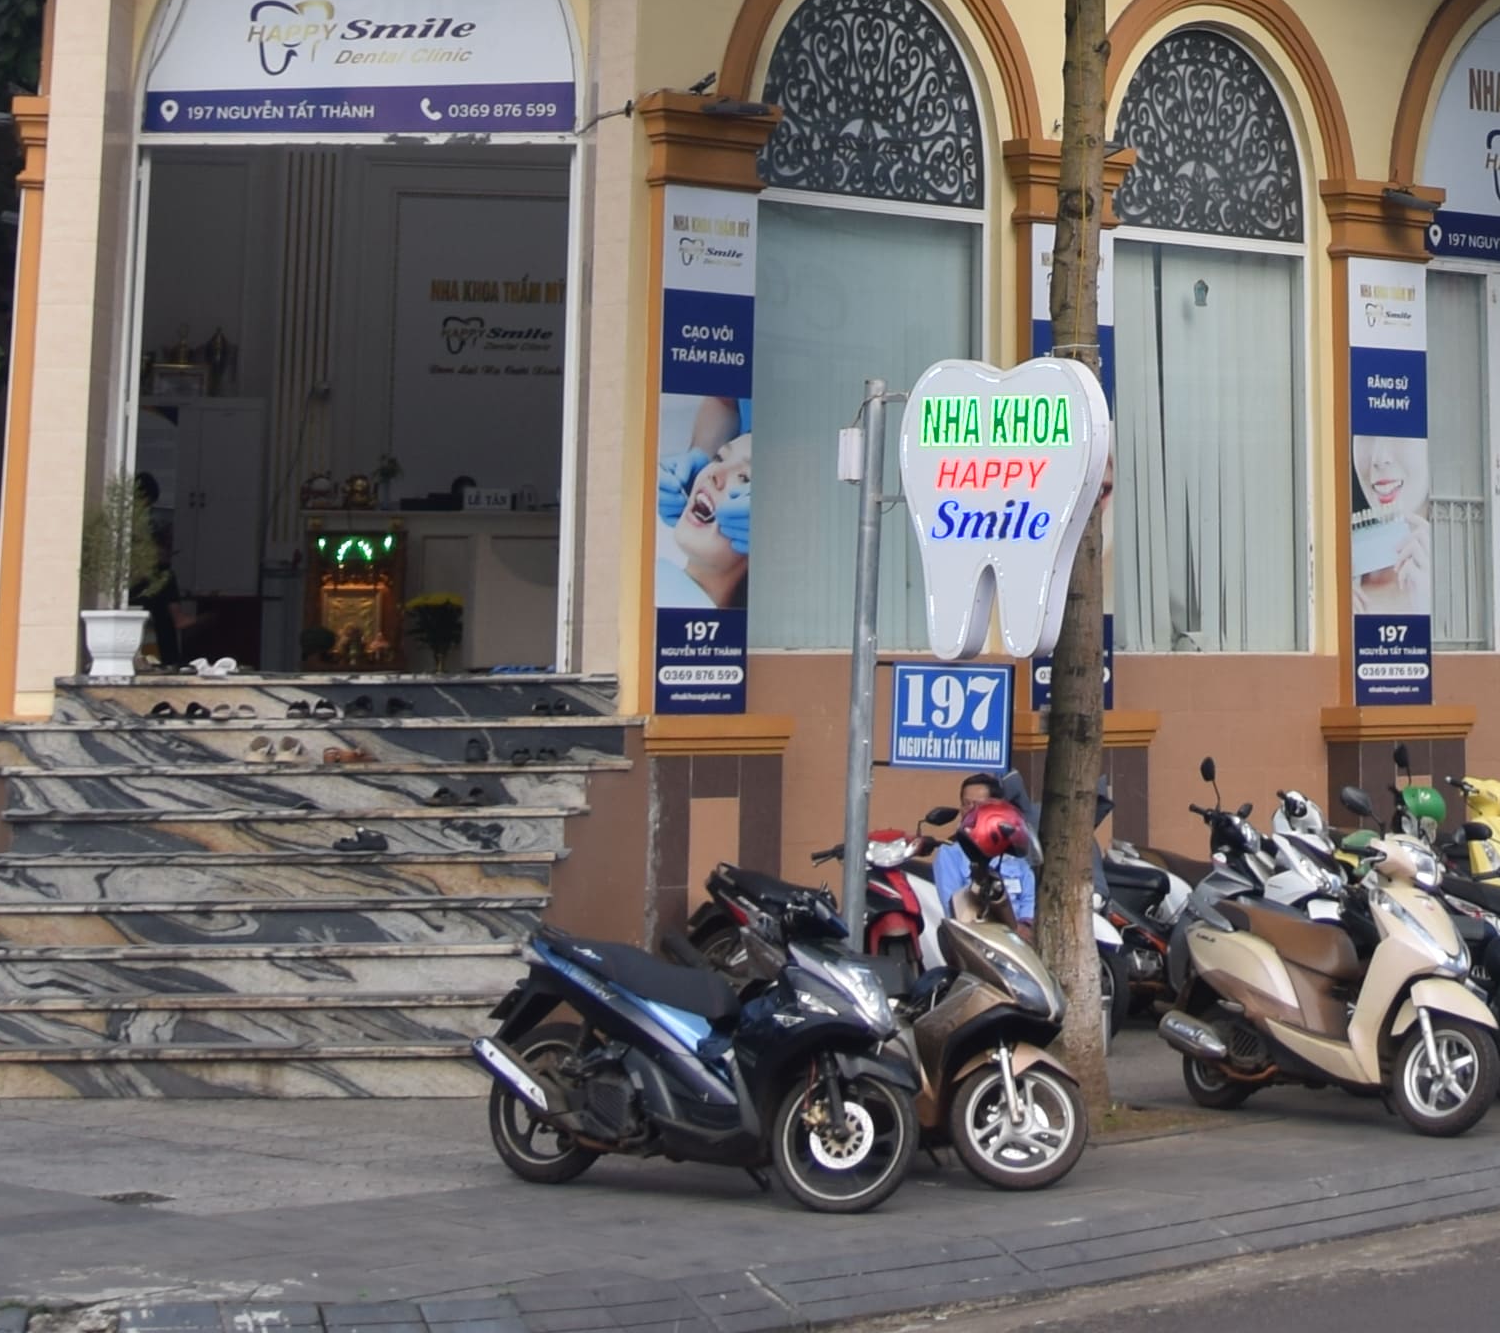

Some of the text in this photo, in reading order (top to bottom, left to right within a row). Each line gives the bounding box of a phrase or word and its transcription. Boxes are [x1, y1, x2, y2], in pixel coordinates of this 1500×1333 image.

[247, 22, 338, 43] HAPPY
[340, 17, 477, 40] Smile
[333, 47, 473, 65] Dental Clinic
[186, 100, 375, 120] 197 NGUYỄN TẤT THÀNH
[447, 102, 557, 118] 0369 876 599
[1448, 233, 1467, 247] 197
[920, 395, 1073, 446] NHA KHOA
[936, 460, 1048, 490] HAPPY
[931, 499, 1051, 540] Smile
[684, 621, 720, 641] 197
[1378, 625, 1408, 642] 197
[663, 670, 739, 680] 0369 876 599
[902, 674, 1000, 732] 197
[898, 730, 1000, 761] NGUYỄN TẤT THÀNH
